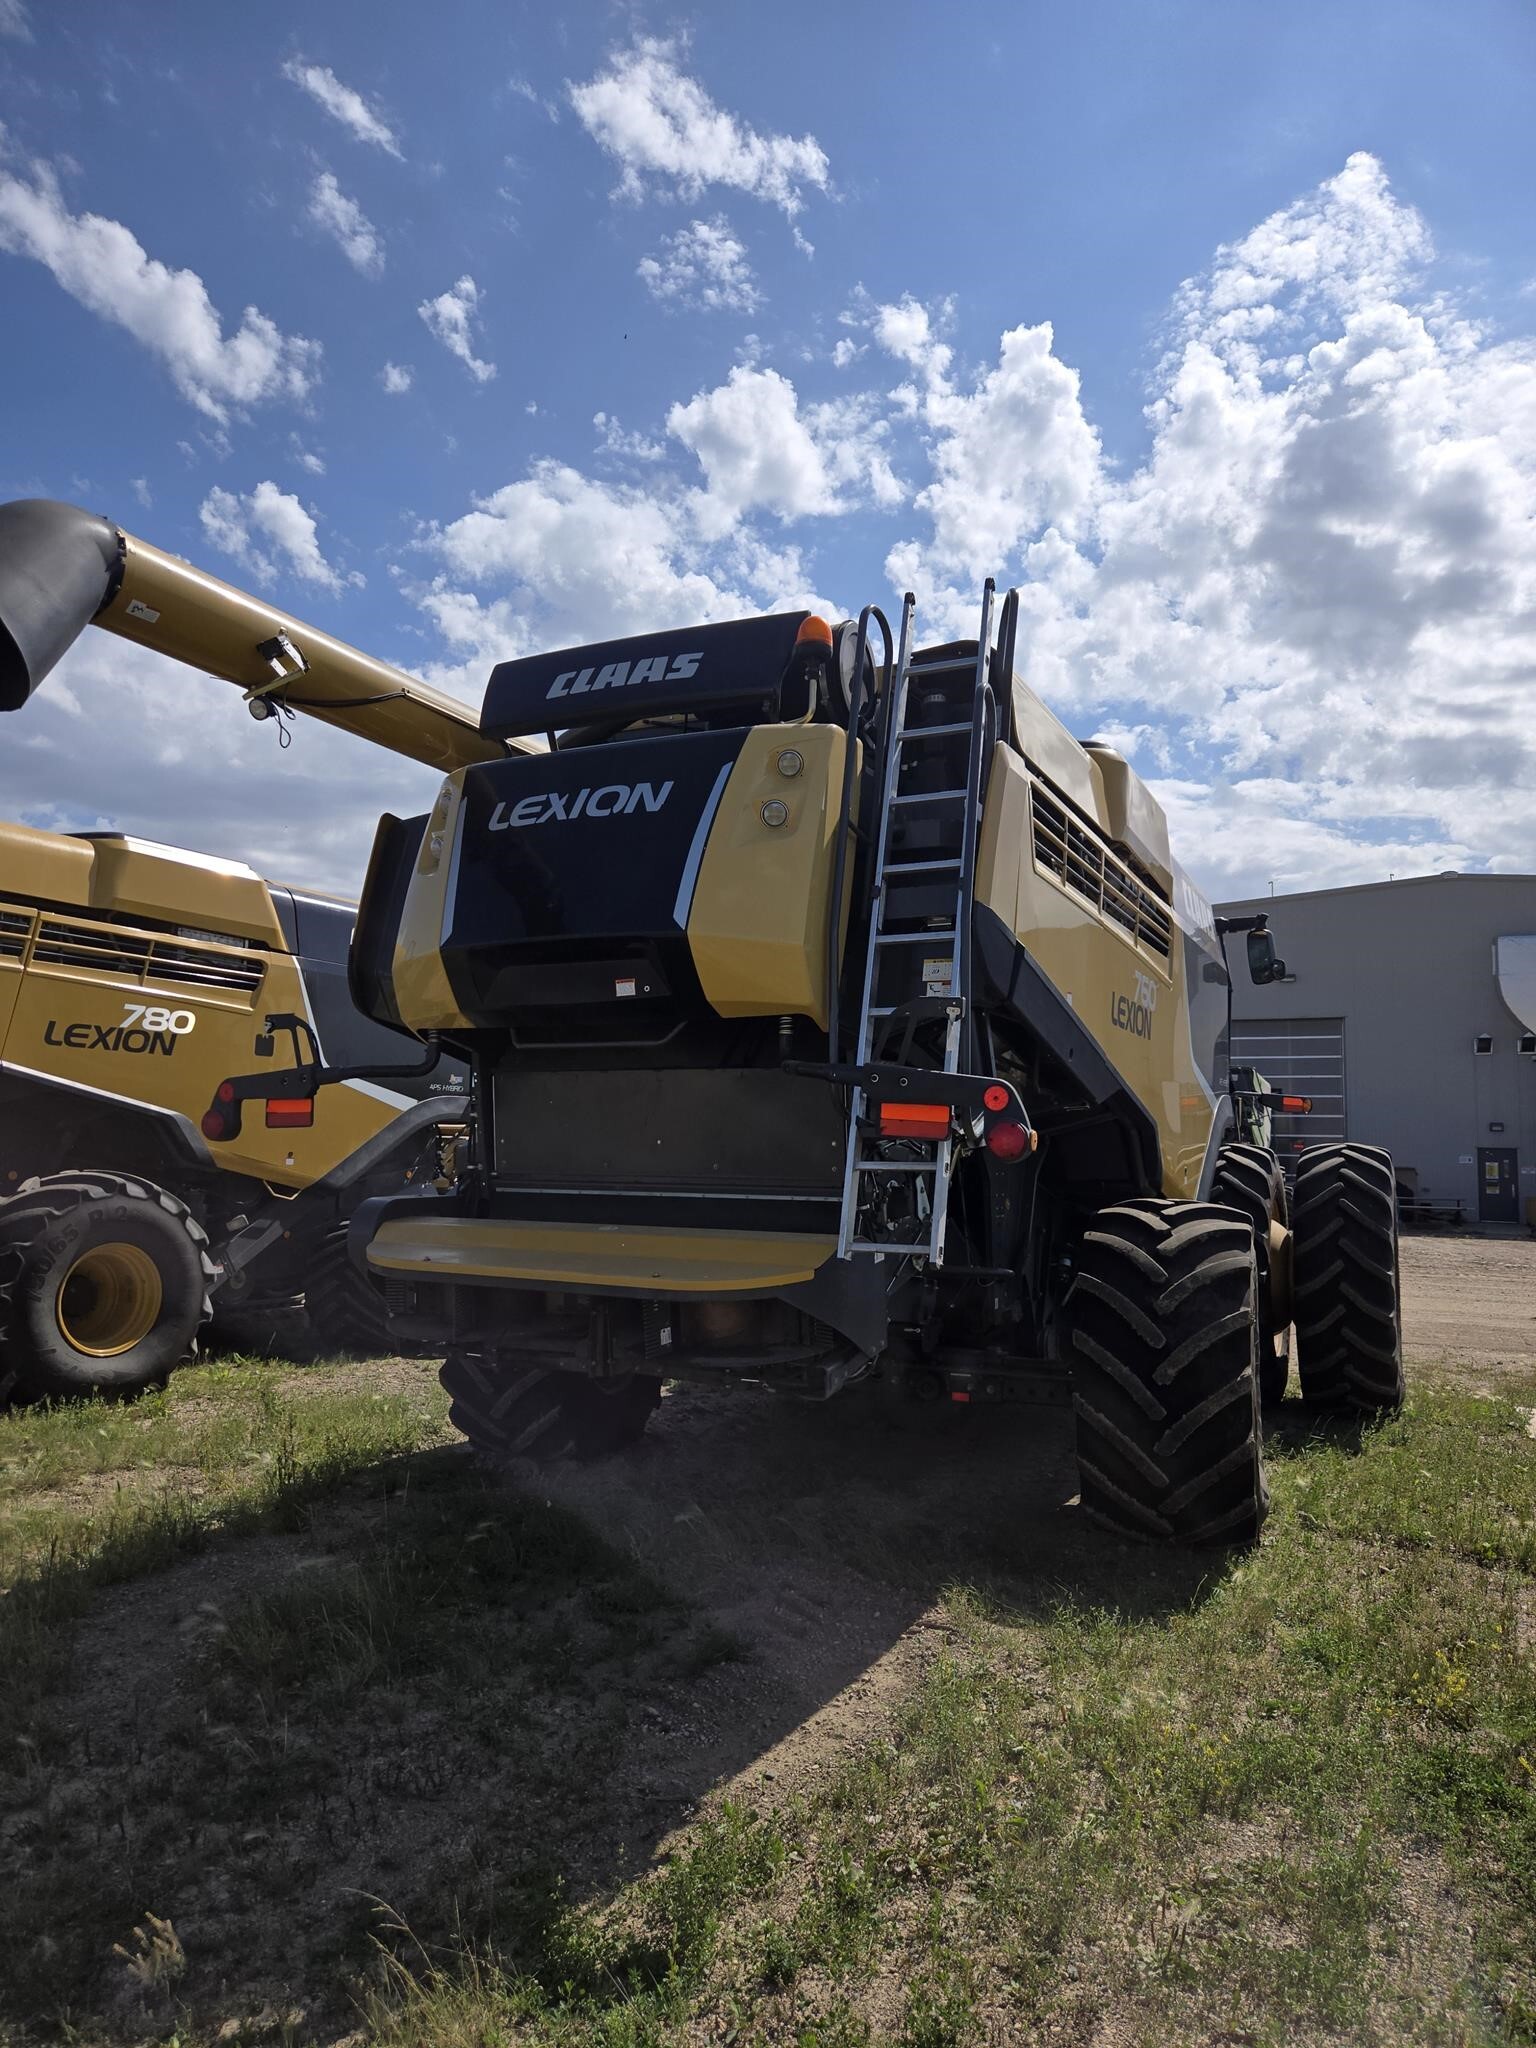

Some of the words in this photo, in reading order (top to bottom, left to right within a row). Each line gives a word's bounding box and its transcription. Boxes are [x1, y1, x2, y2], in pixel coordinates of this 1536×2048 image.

[545, 652, 705, 700] CLAAS
[488, 780, 675, 832] LEXION
[119, 1003, 196, 1034] 780
[1111, 991, 1152, 1040] LEXION
[44, 1020, 178, 1056] LEXION
[429, 1083, 441, 1091] APS
